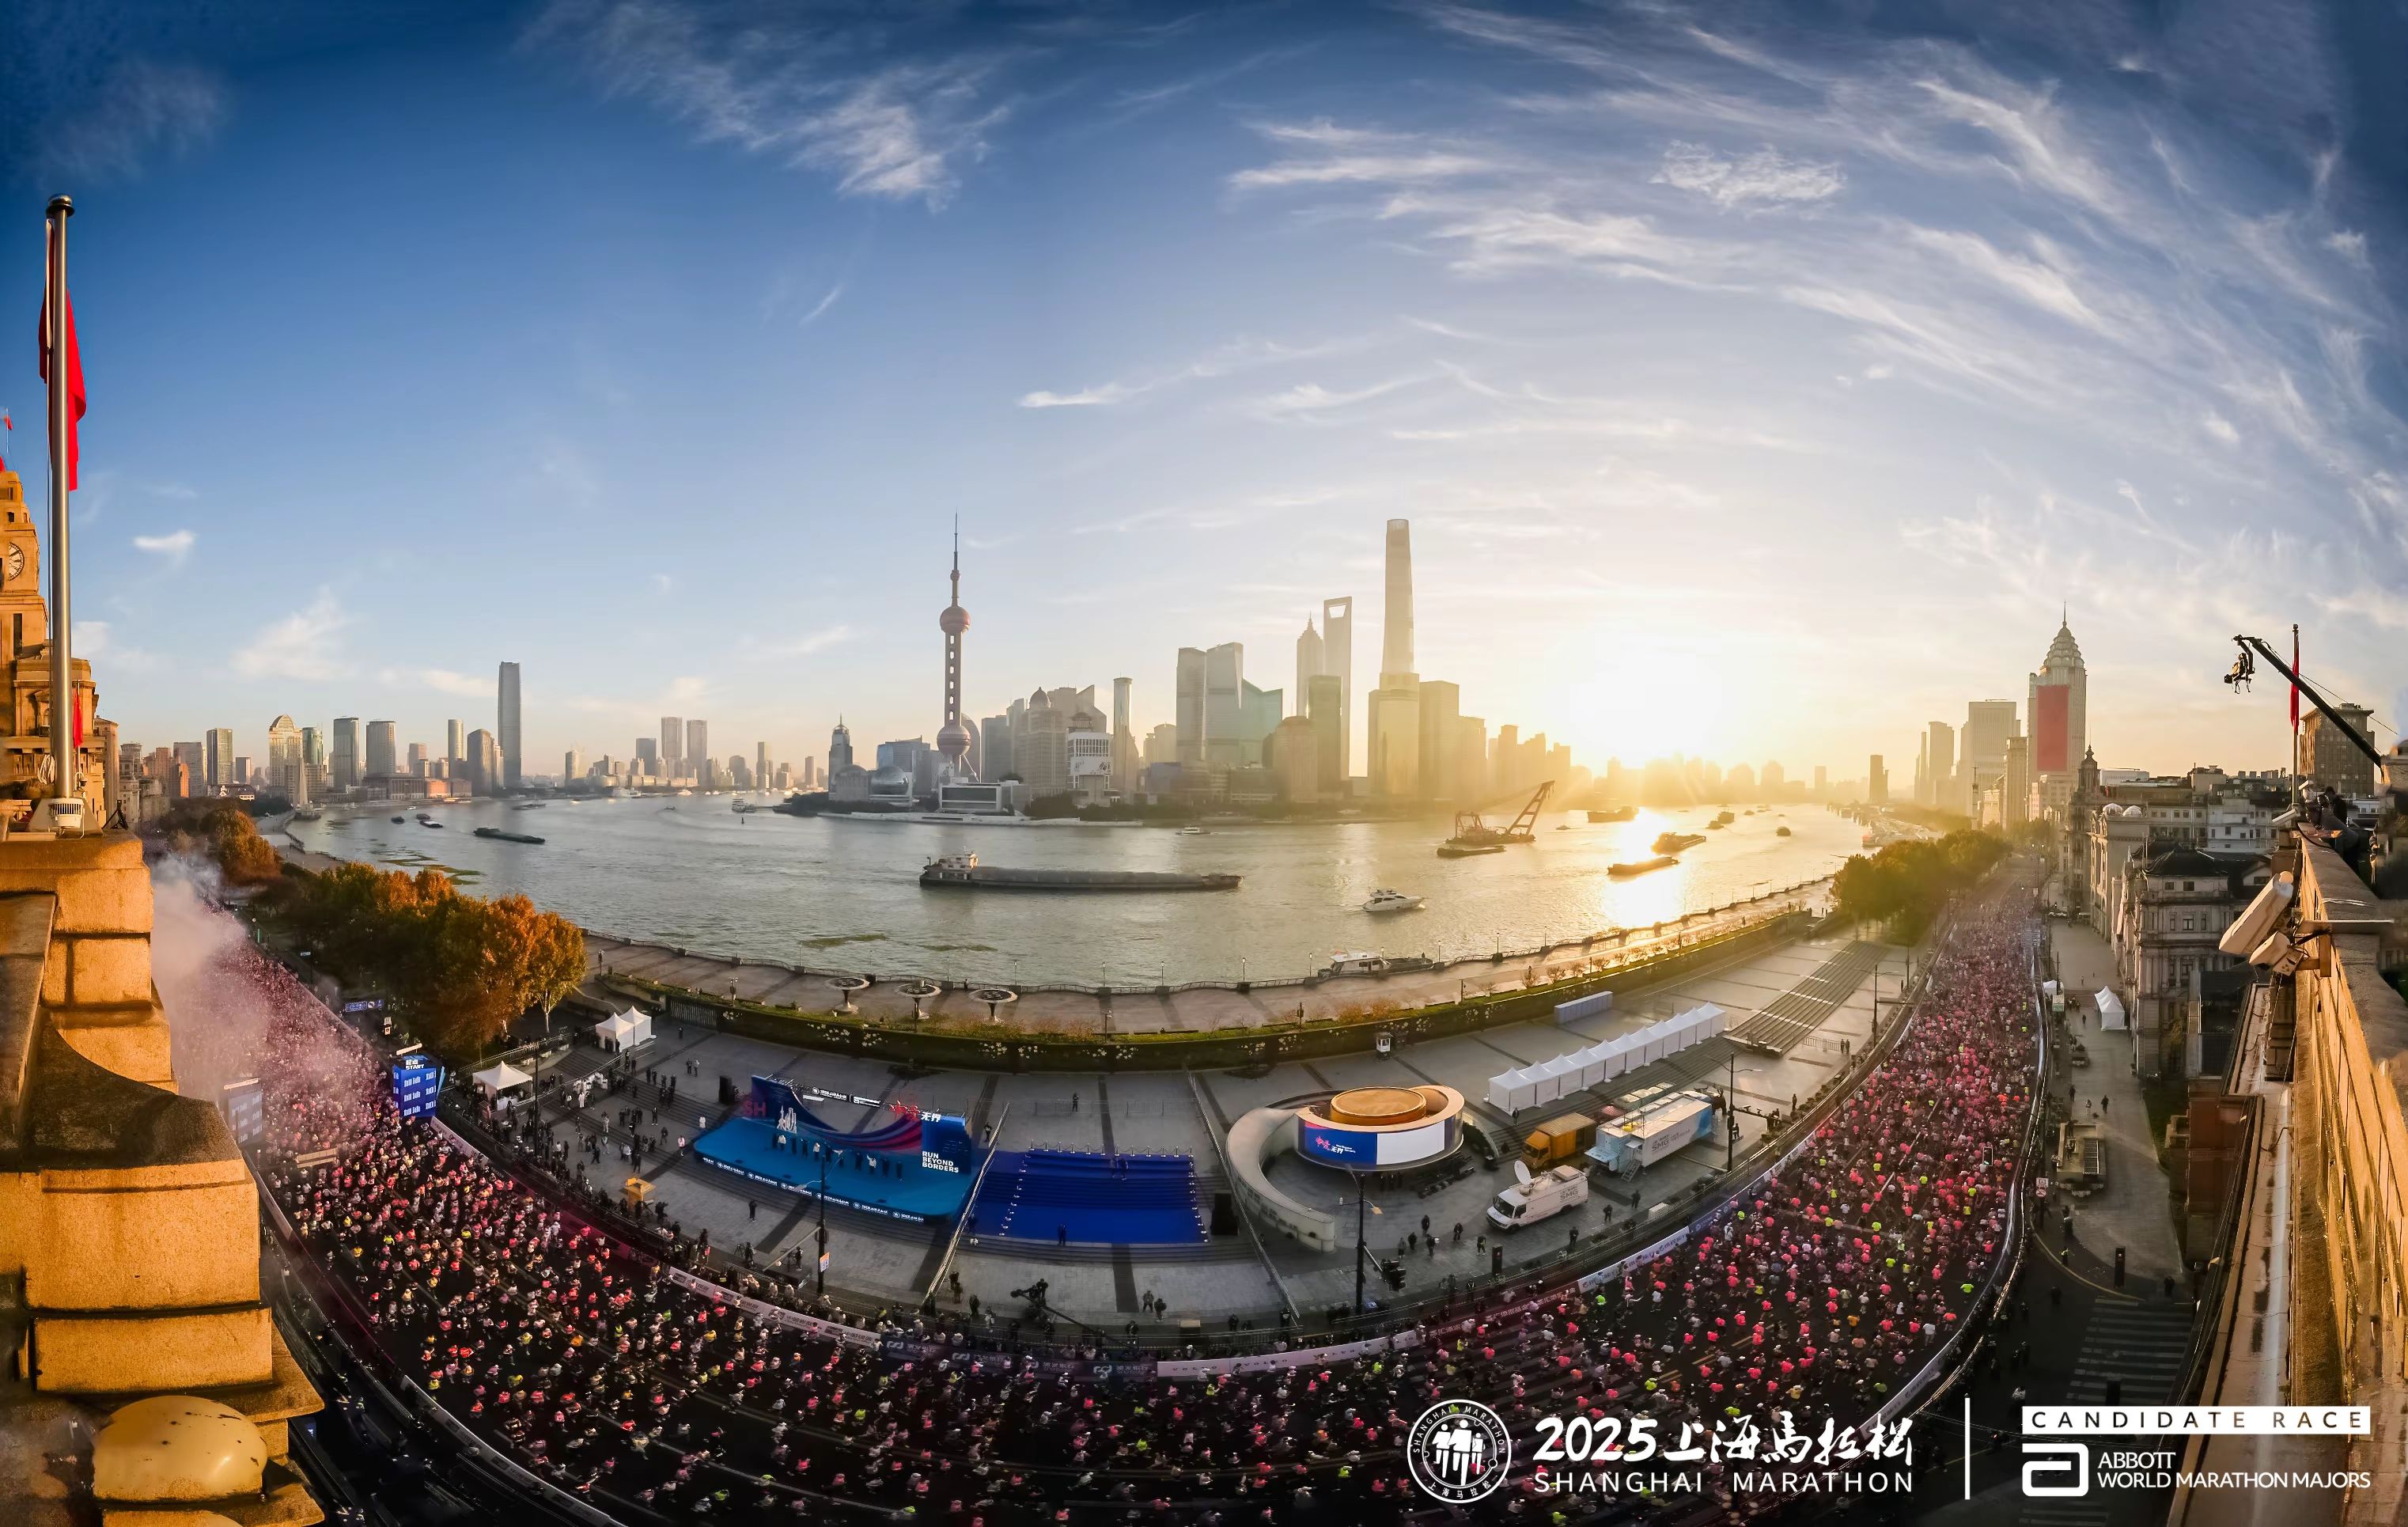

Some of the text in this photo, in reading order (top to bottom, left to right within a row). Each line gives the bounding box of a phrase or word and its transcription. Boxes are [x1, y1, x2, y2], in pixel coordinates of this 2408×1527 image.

[1652, 1139, 1669, 1152] SMG
[922, 1150, 939, 1159] RUN
[922, 1156, 954, 1167] BEYOND
[922, 1161, 959, 1173] BORDERS
[1560, 1188, 1578, 1199] SMG
